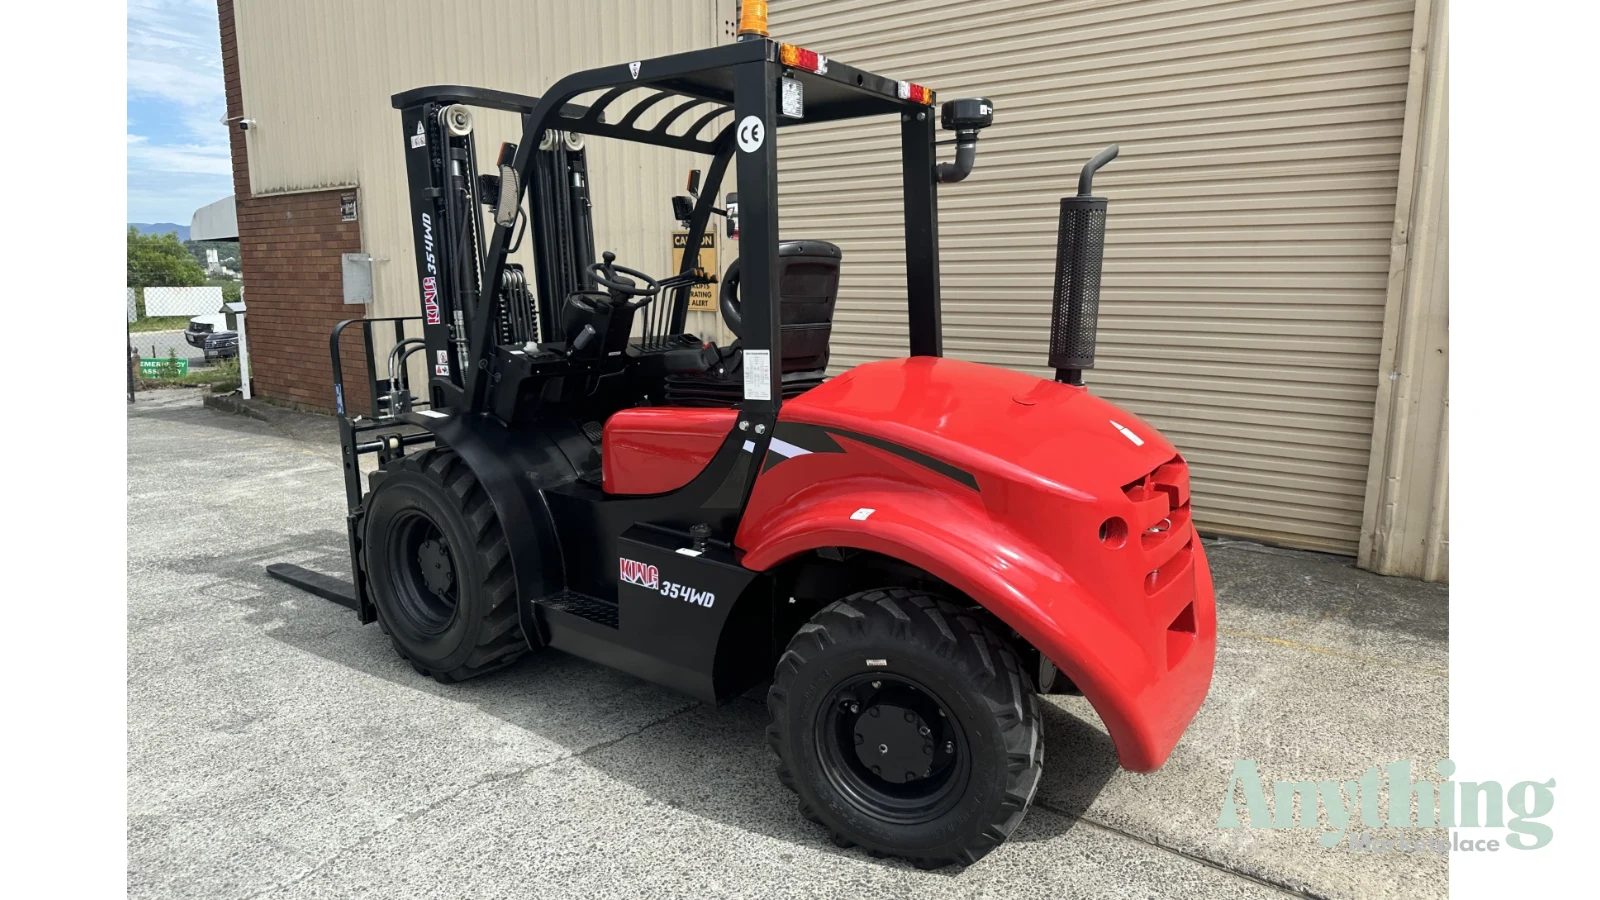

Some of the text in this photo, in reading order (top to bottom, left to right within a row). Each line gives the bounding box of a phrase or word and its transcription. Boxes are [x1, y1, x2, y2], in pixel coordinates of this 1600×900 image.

[741, 124, 758, 144] CE
[422, 212, 441, 325] KING 354WD
[620, 557, 715, 608] KING 354WD
